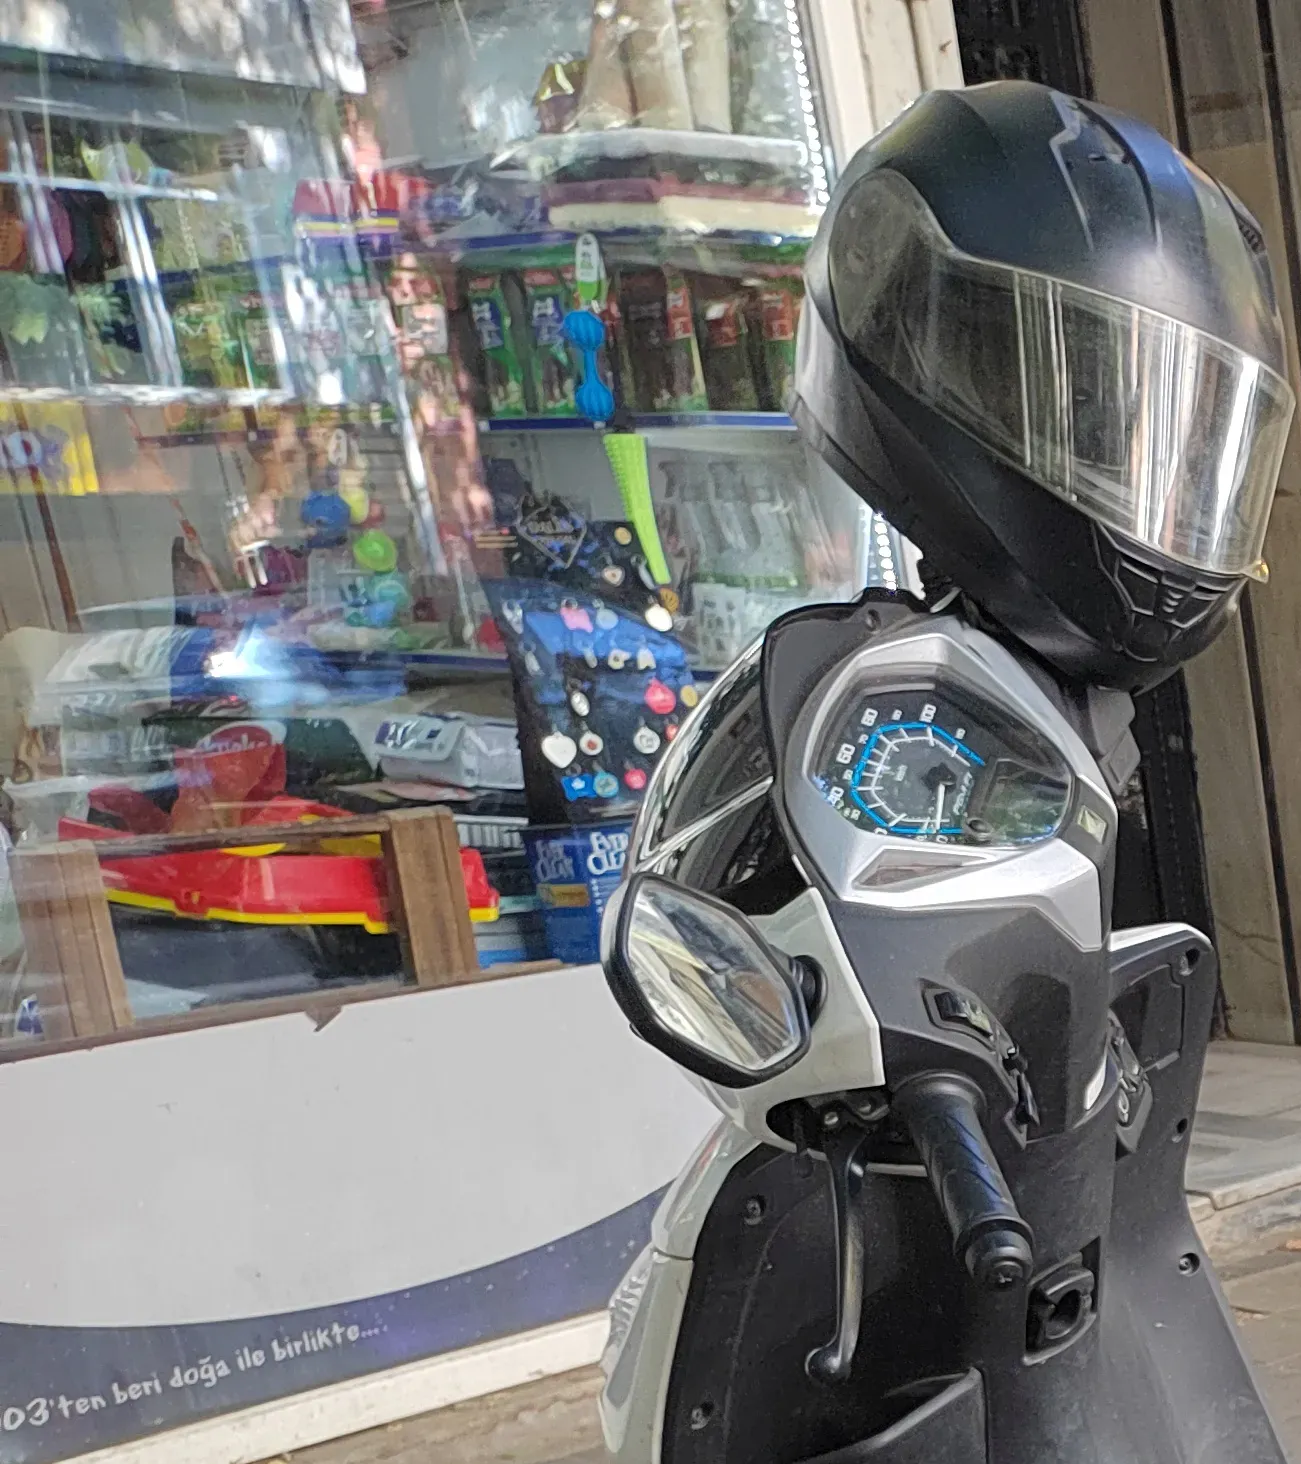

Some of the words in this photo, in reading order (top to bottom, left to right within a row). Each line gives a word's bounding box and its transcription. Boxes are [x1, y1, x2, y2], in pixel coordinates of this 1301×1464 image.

[836, 743, 856, 764] 60
[112, 1375, 162, 1404] beri
[170, 1356, 231, 1388] doğa
[236, 1349, 266, 1371] ile
